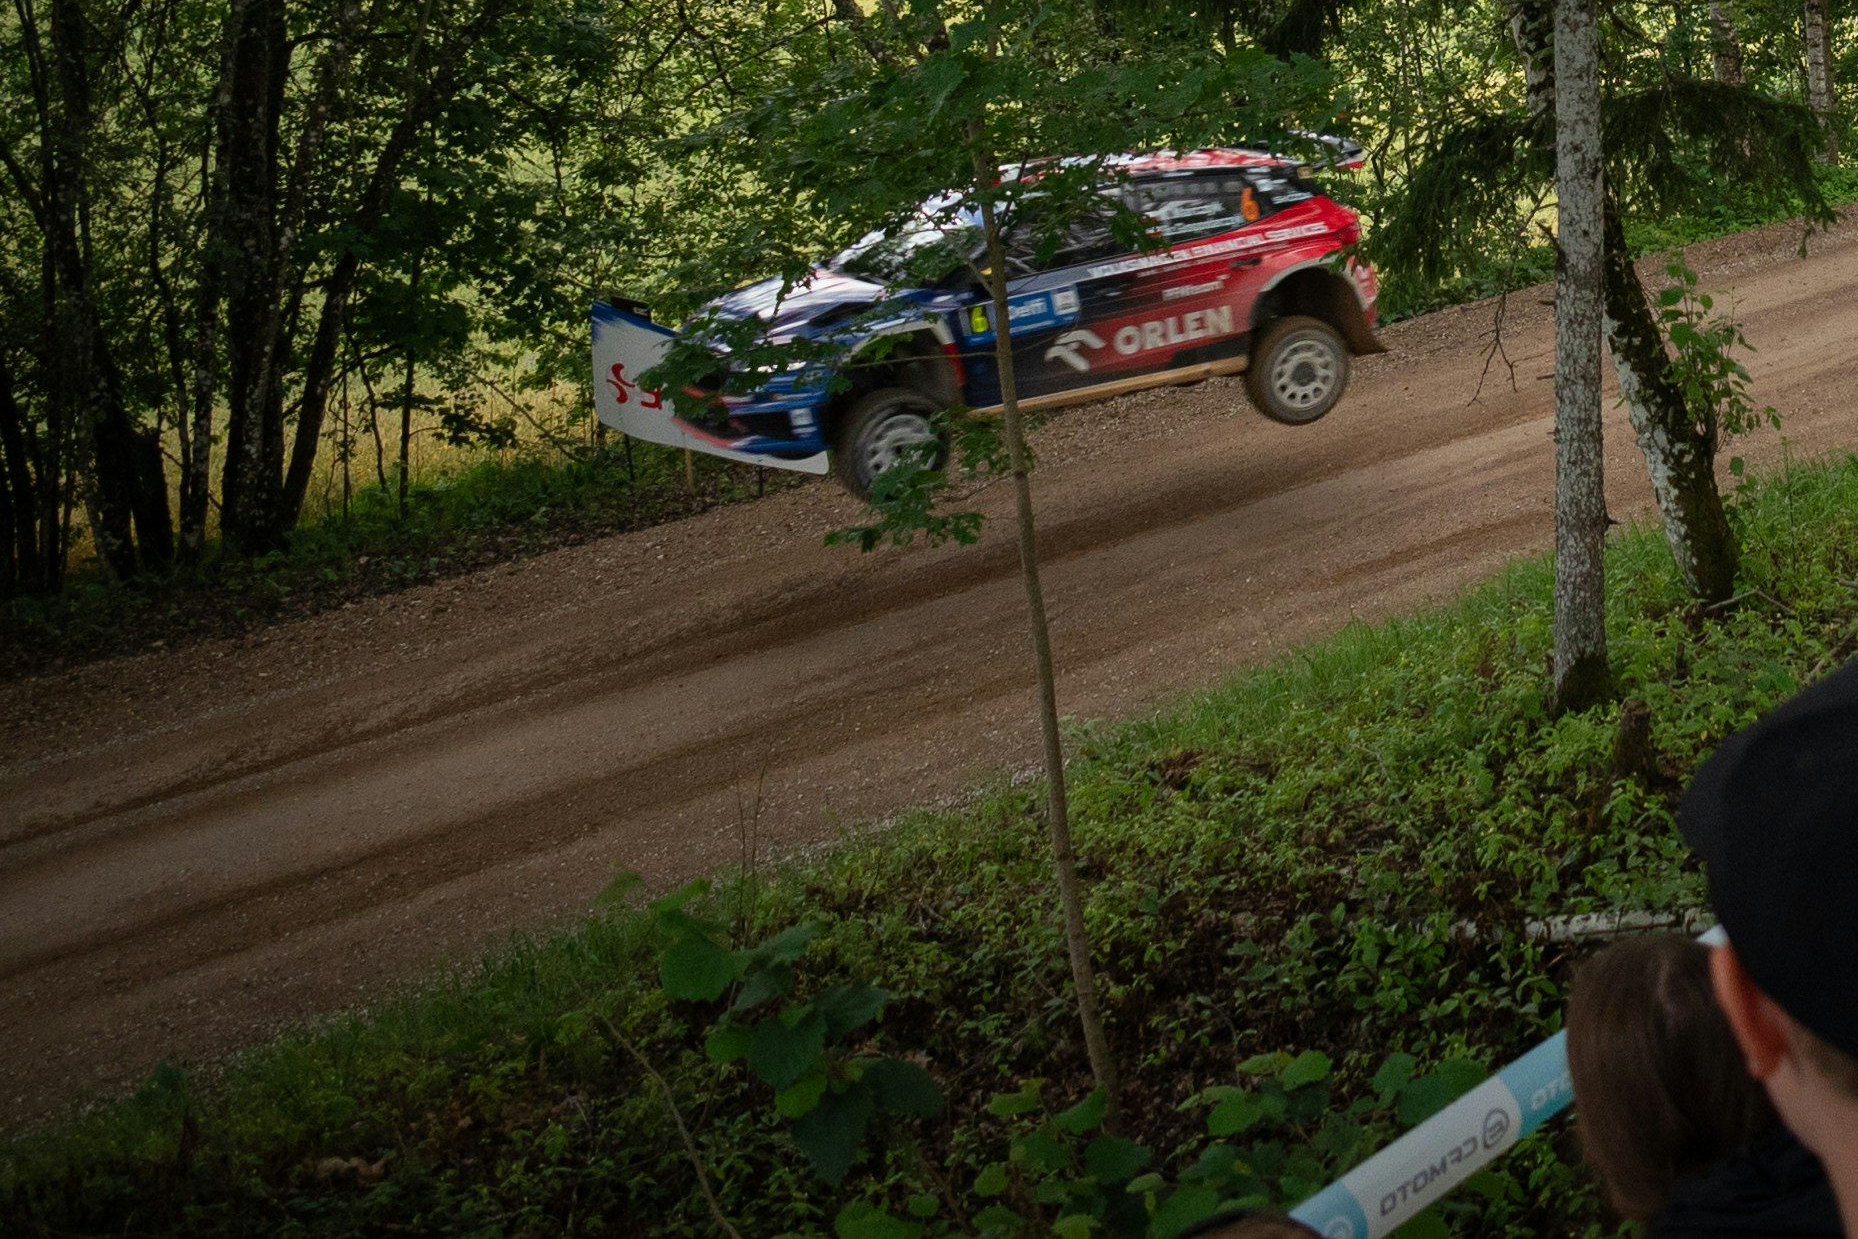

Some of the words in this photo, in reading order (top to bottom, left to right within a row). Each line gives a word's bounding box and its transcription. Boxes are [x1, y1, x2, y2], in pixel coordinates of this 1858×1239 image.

[1240, 187, 1260, 222] 6
[971, 305, 989, 333] 6
[1112, 305, 1235, 356] ORLEN
